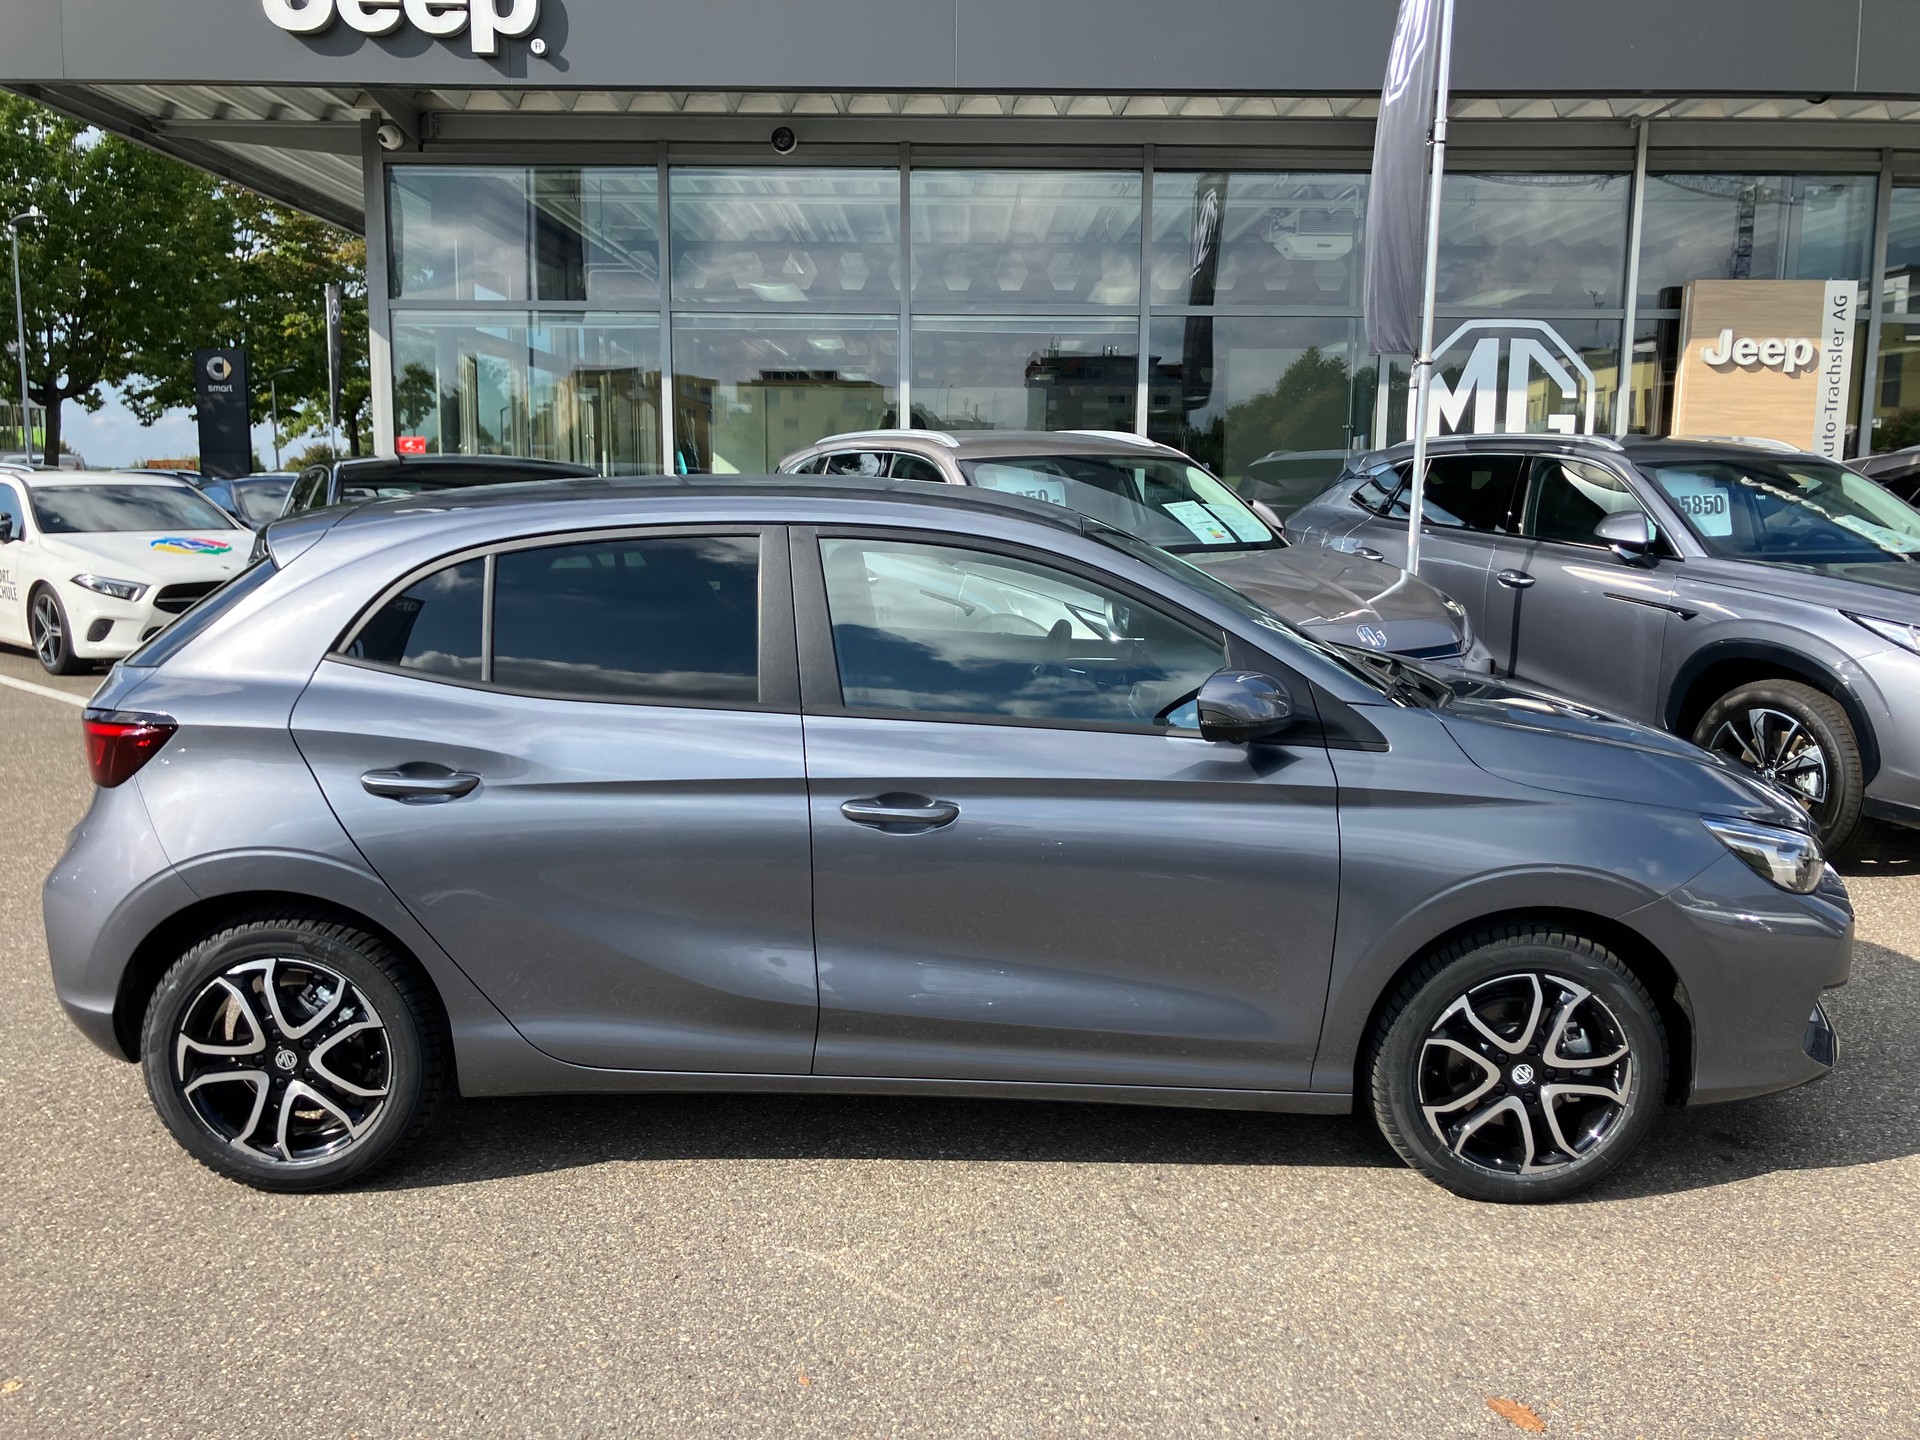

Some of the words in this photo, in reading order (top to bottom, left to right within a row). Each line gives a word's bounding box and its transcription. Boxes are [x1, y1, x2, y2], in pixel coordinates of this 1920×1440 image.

[1832, 294, 1848, 321] AG
[1700, 328, 1814, 373] Jeep
[207, 383, 233, 393] smart
[1822, 327, 1846, 458] uto-Trachsler
[277, 1051, 296, 1069] MG
